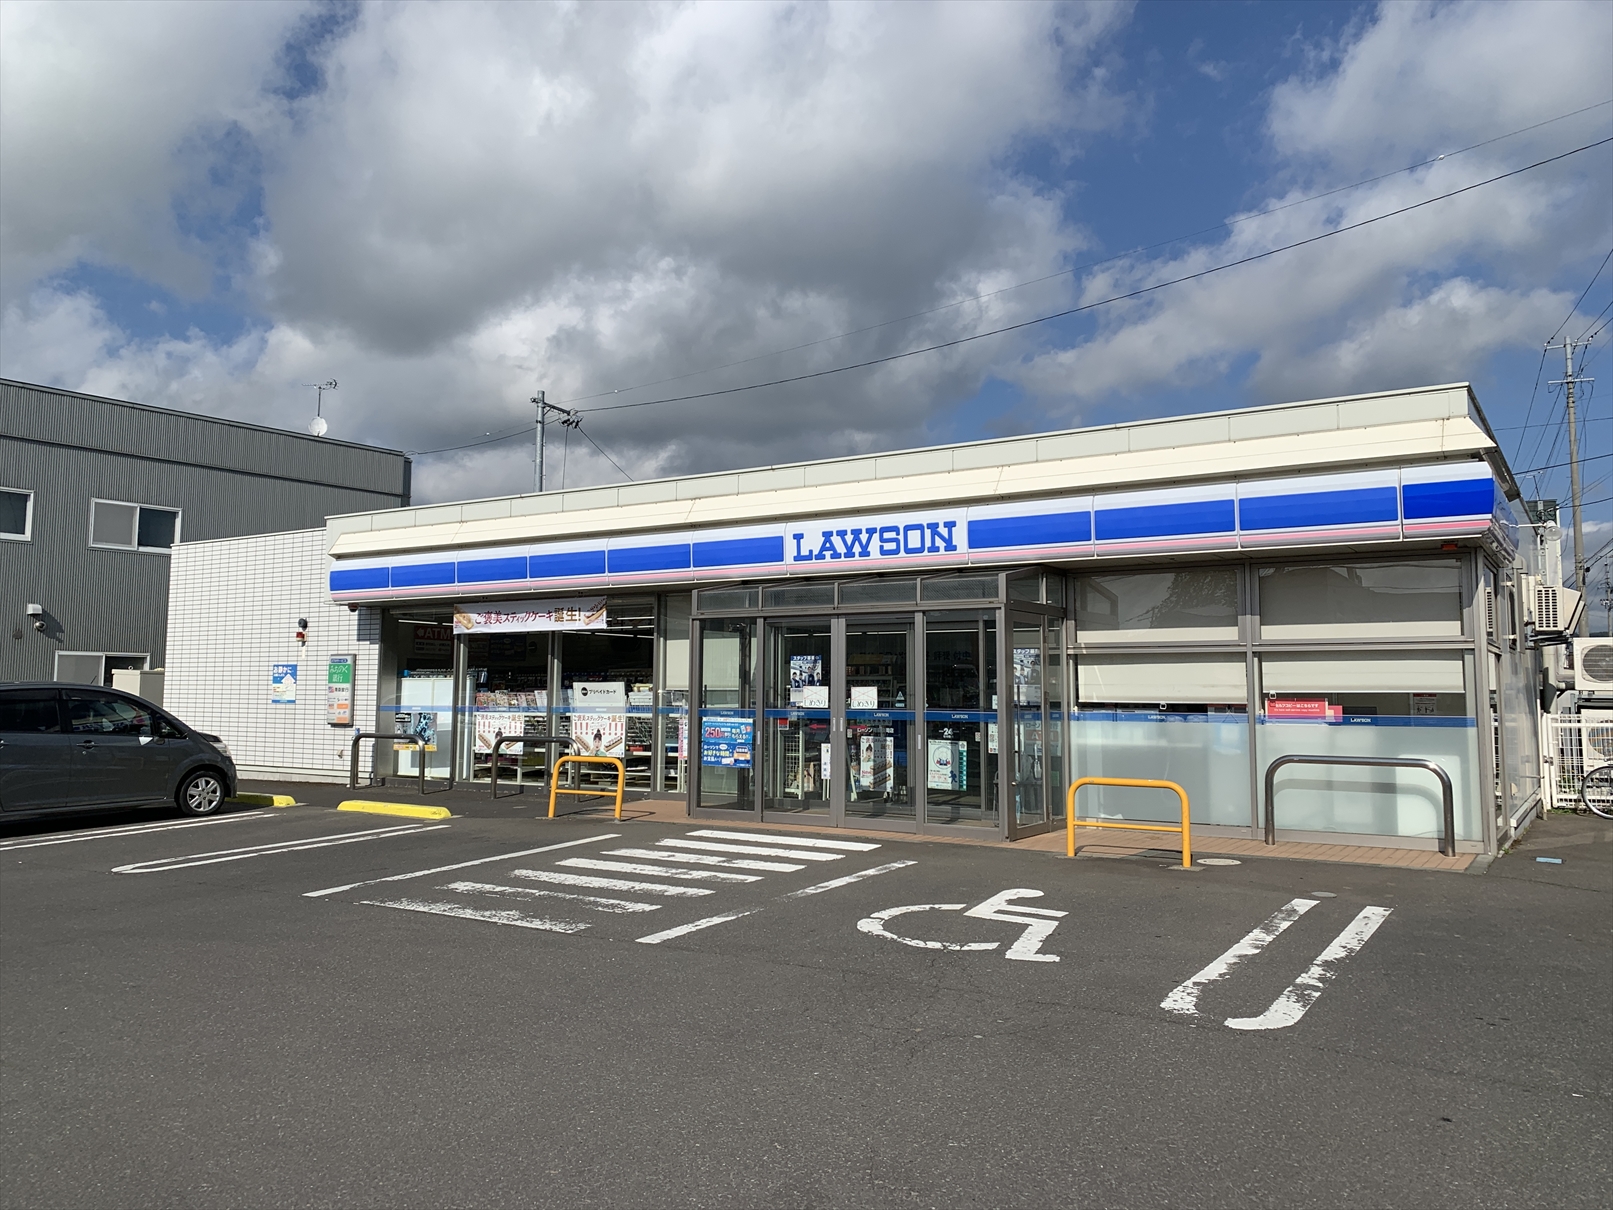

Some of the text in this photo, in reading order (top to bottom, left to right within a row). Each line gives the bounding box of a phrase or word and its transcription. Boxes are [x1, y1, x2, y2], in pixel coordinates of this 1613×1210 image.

[793, 521, 957, 561] LAWSON
[424, 627, 451, 640] ATM
[329, 664, 349, 674] みちのく
